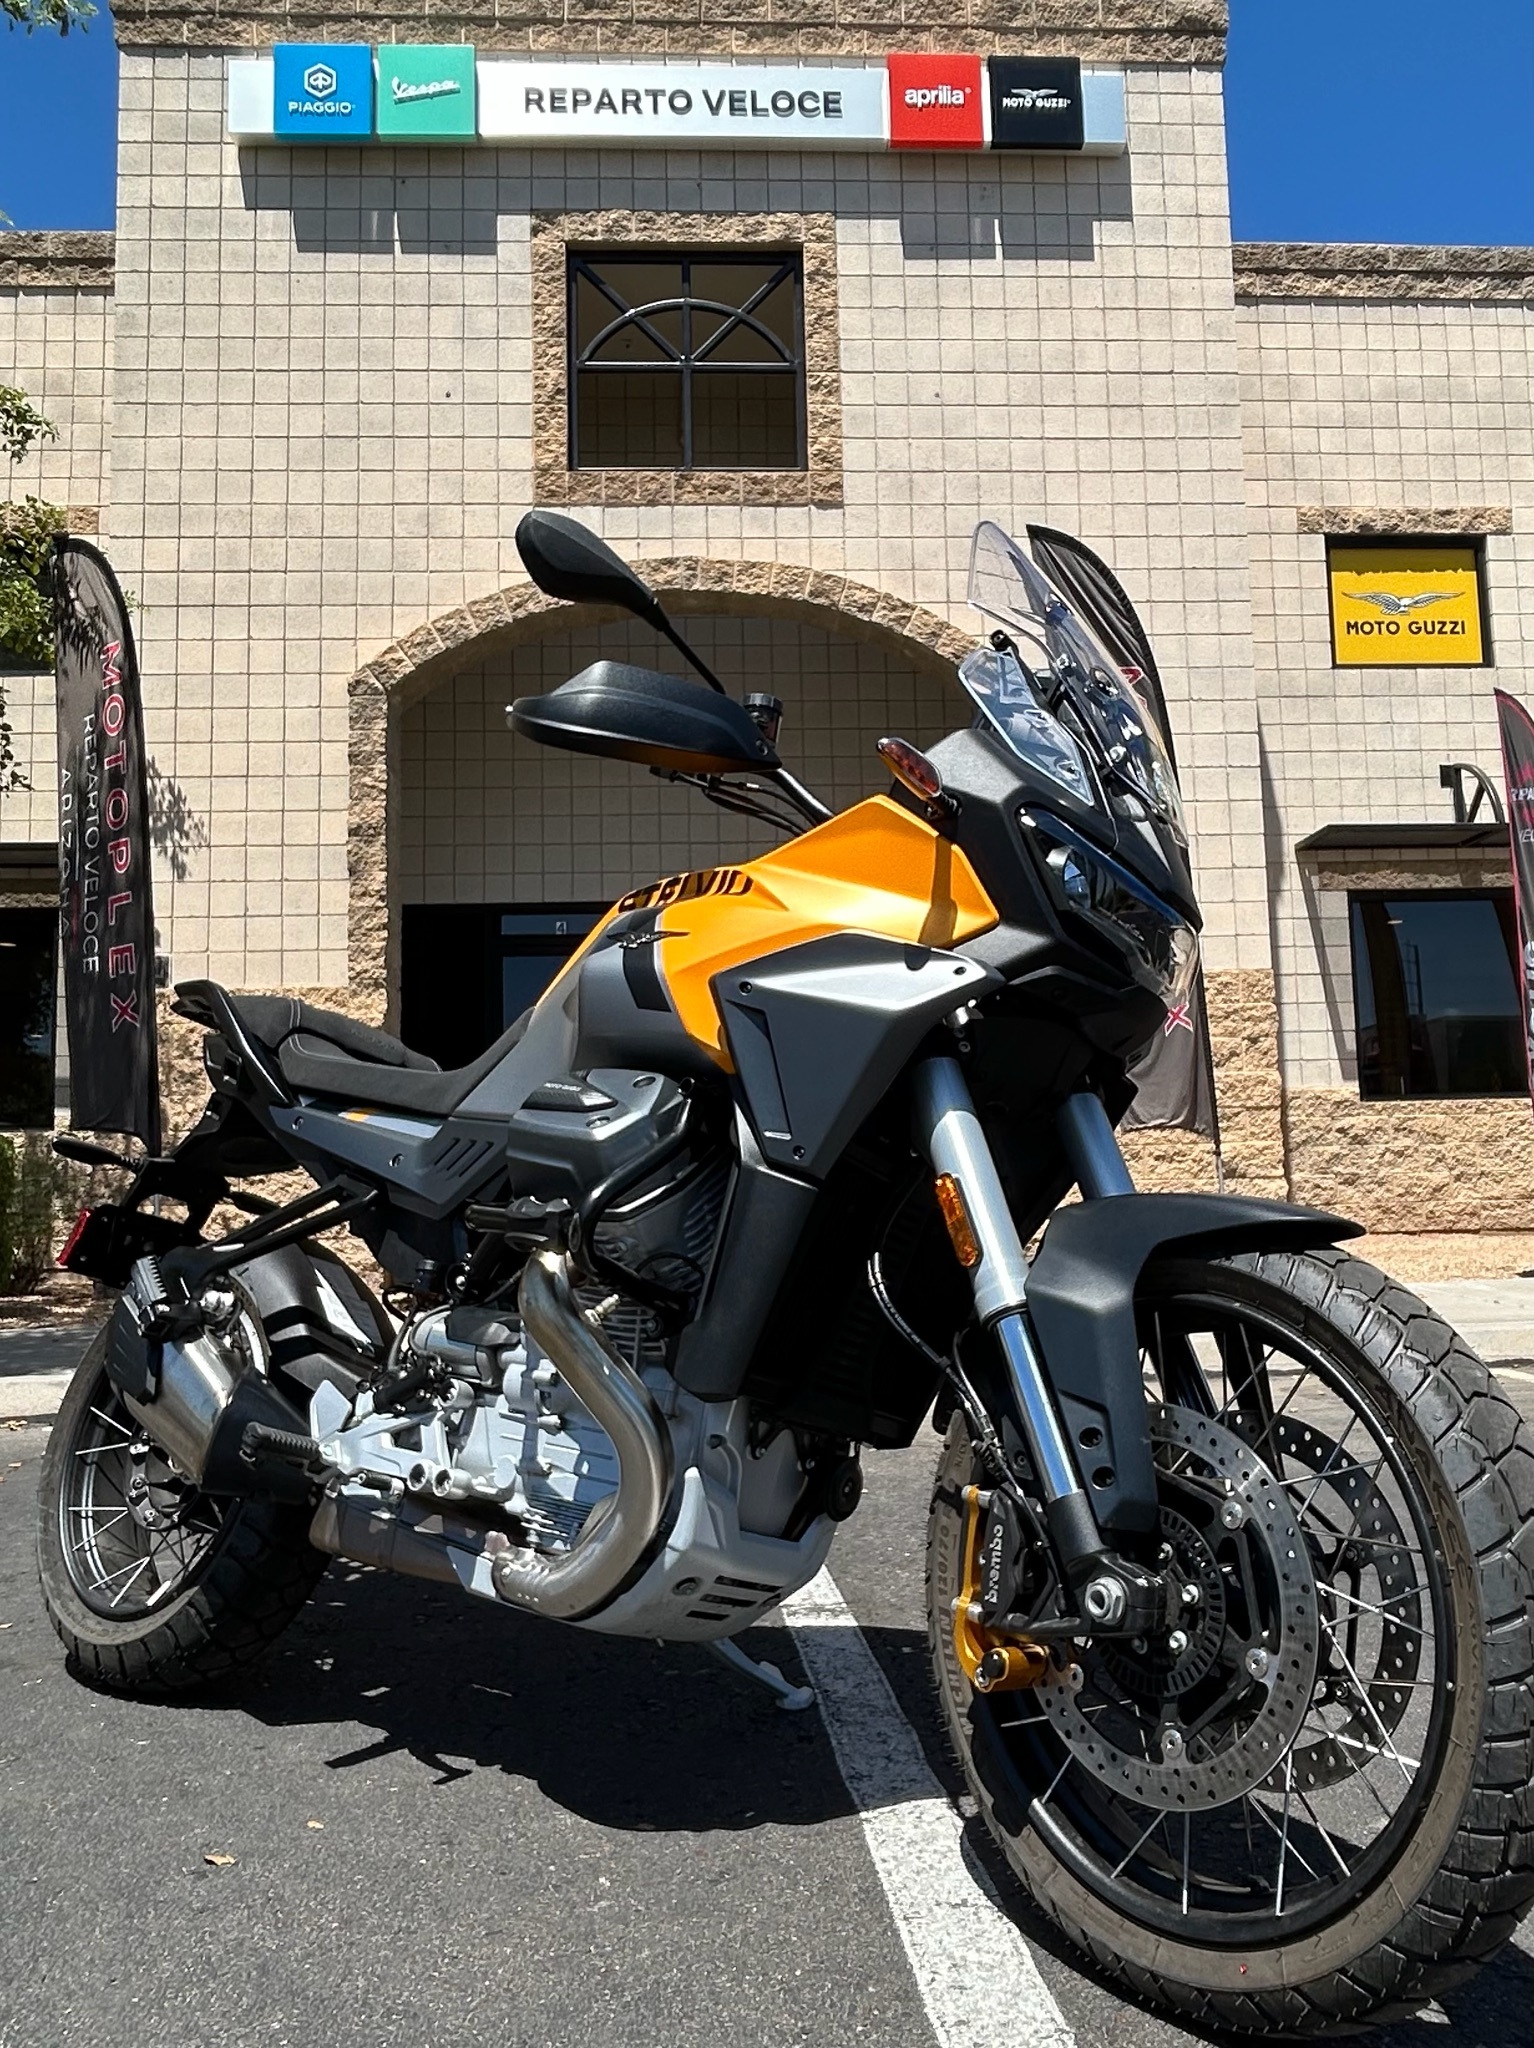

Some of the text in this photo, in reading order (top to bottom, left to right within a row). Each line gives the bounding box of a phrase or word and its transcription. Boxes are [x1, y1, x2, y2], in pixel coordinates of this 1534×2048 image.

[391, 76, 461, 100] Vespa
[524, 87, 844, 118] REPARTO VELOCE
[904, 85, 965, 108] aprilia
[1002, 97, 1067, 109] MOTO GUZZI
[288, 101, 352, 114] PIAGGIO
[1346, 620, 1467, 636] MOTO GUZZI
[83, 713, 101, 974] REPARTO VELOCE
[100, 640, 140, 1033] MOTOPLEX
[938, 1524, 950, 1596] 120/70
[985, 1524, 1004, 1604] brembo
[939, 1612, 975, 1735] MICHELIN
